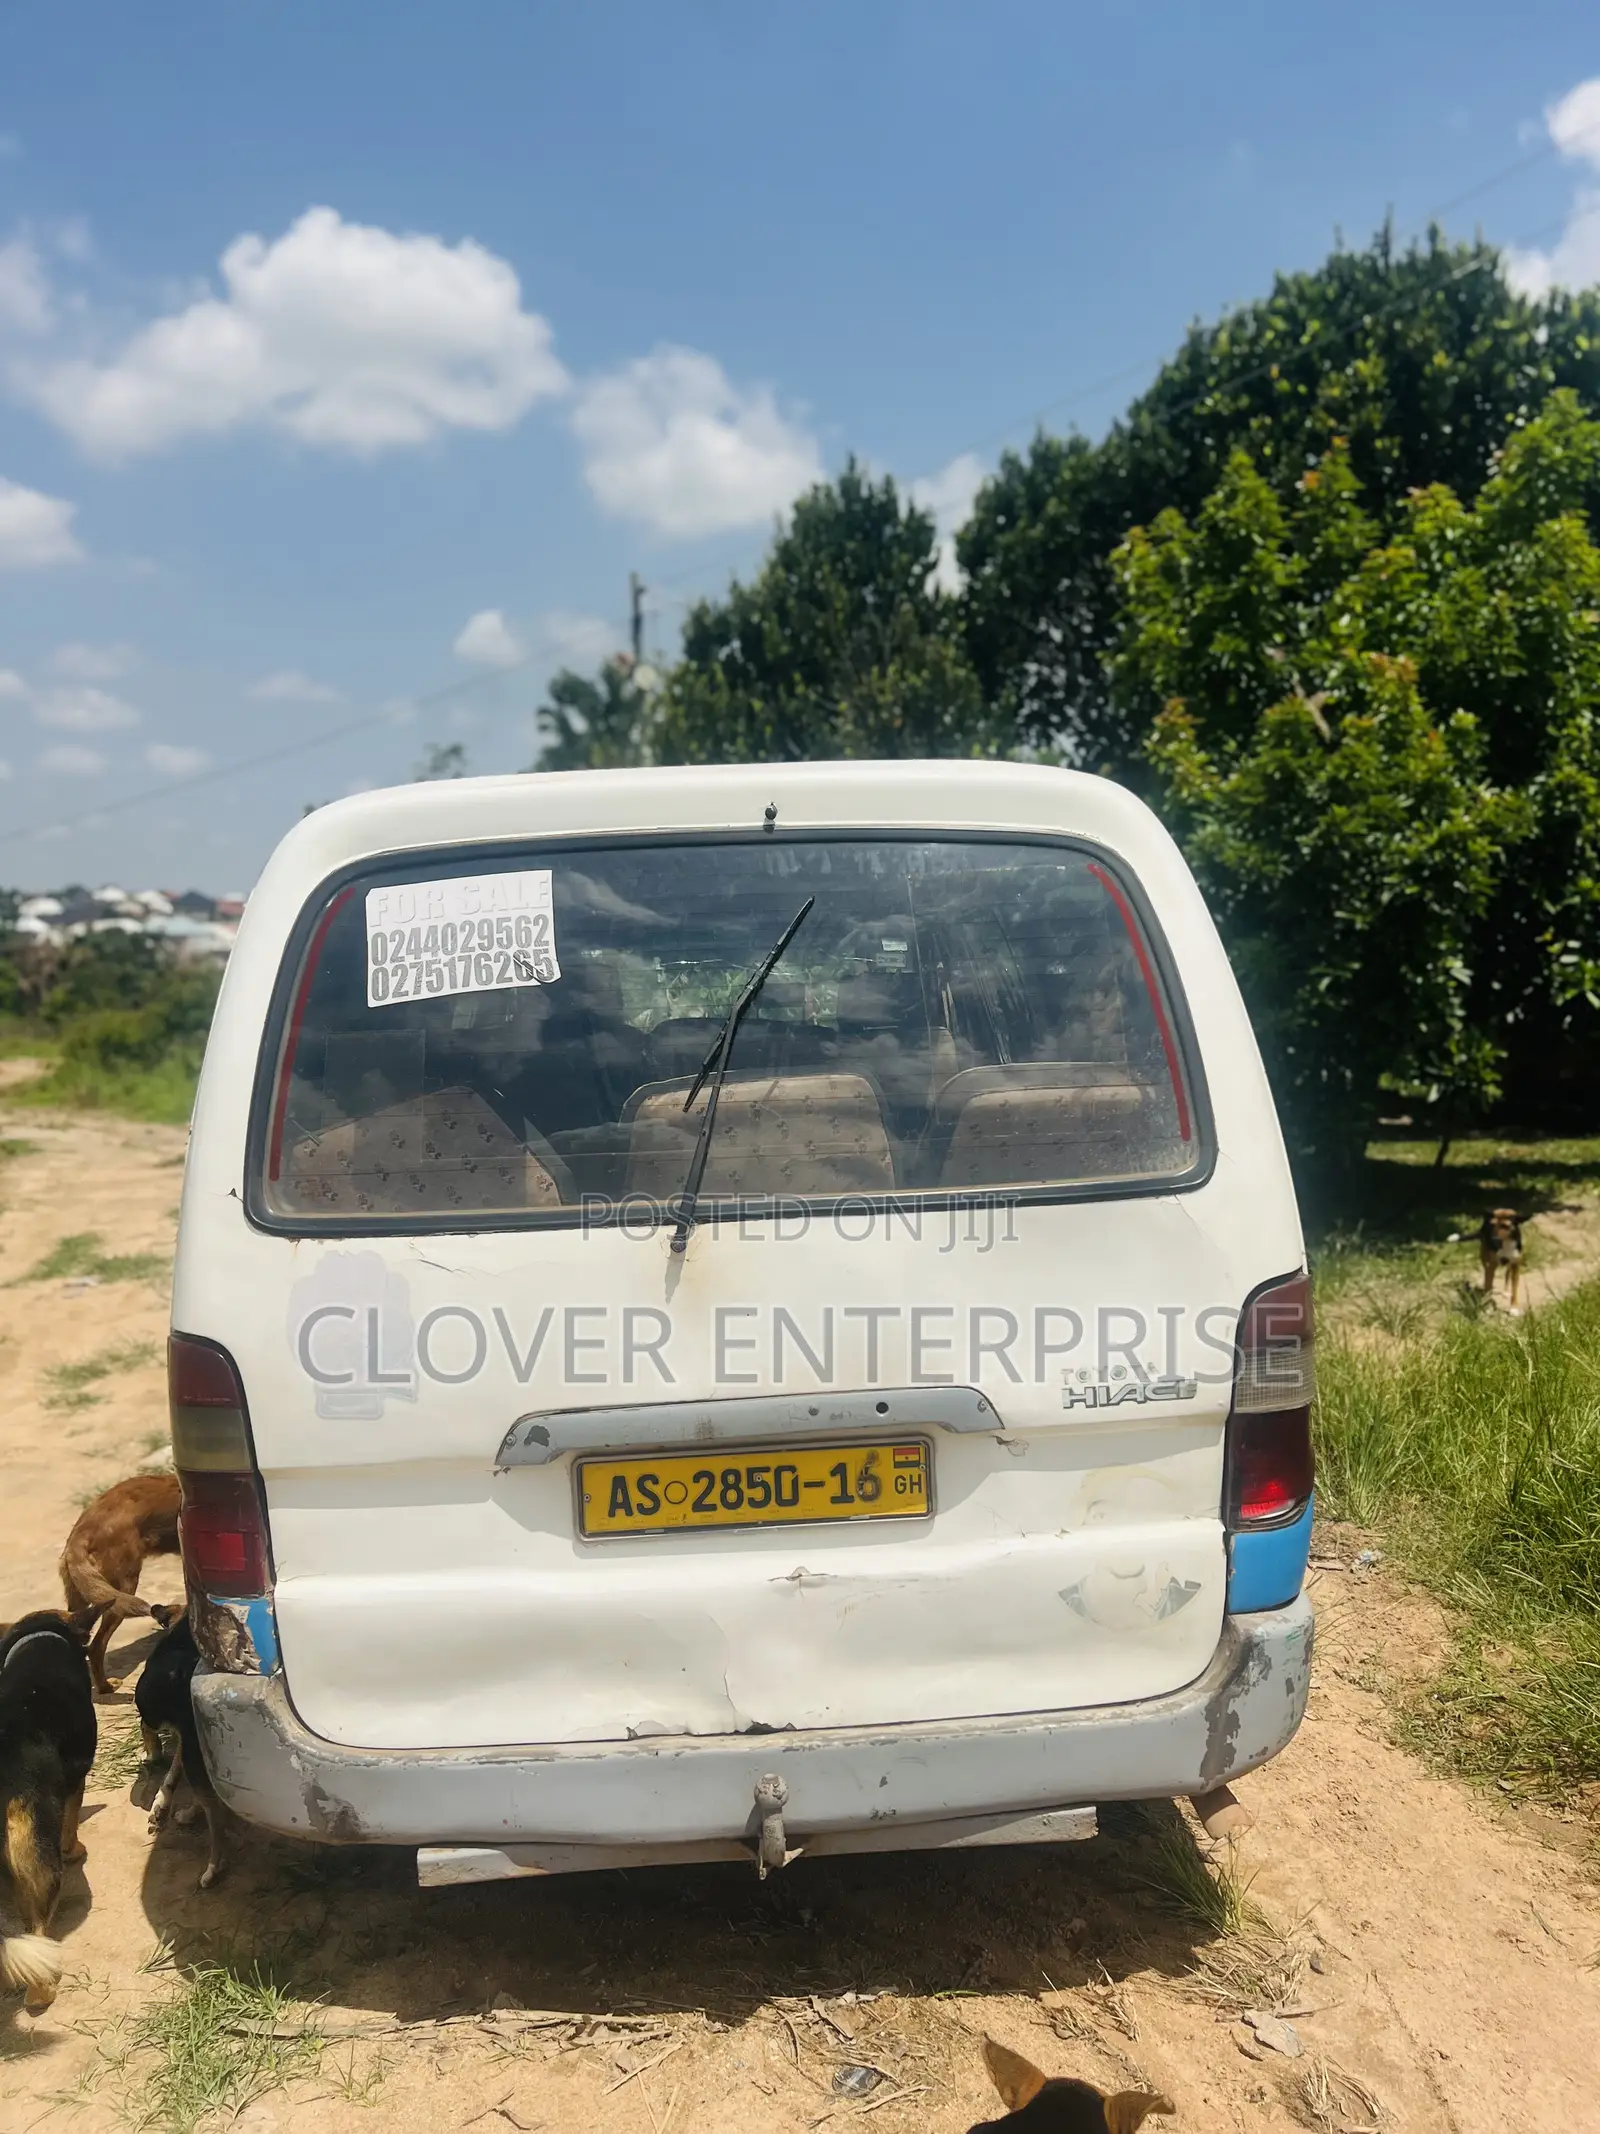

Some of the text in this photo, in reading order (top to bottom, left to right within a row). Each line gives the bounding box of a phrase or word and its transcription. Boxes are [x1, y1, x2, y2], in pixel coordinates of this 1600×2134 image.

[369, 877, 550, 927] FOR SALE
[371, 914, 550, 967] 0244029562
[371, 948, 555, 1001] 0275176265
[1061, 1380, 1197, 1409] HIACE
[608, 1449, 882, 1518] AS 2850-16
[894, 1474, 923, 1495] GH
